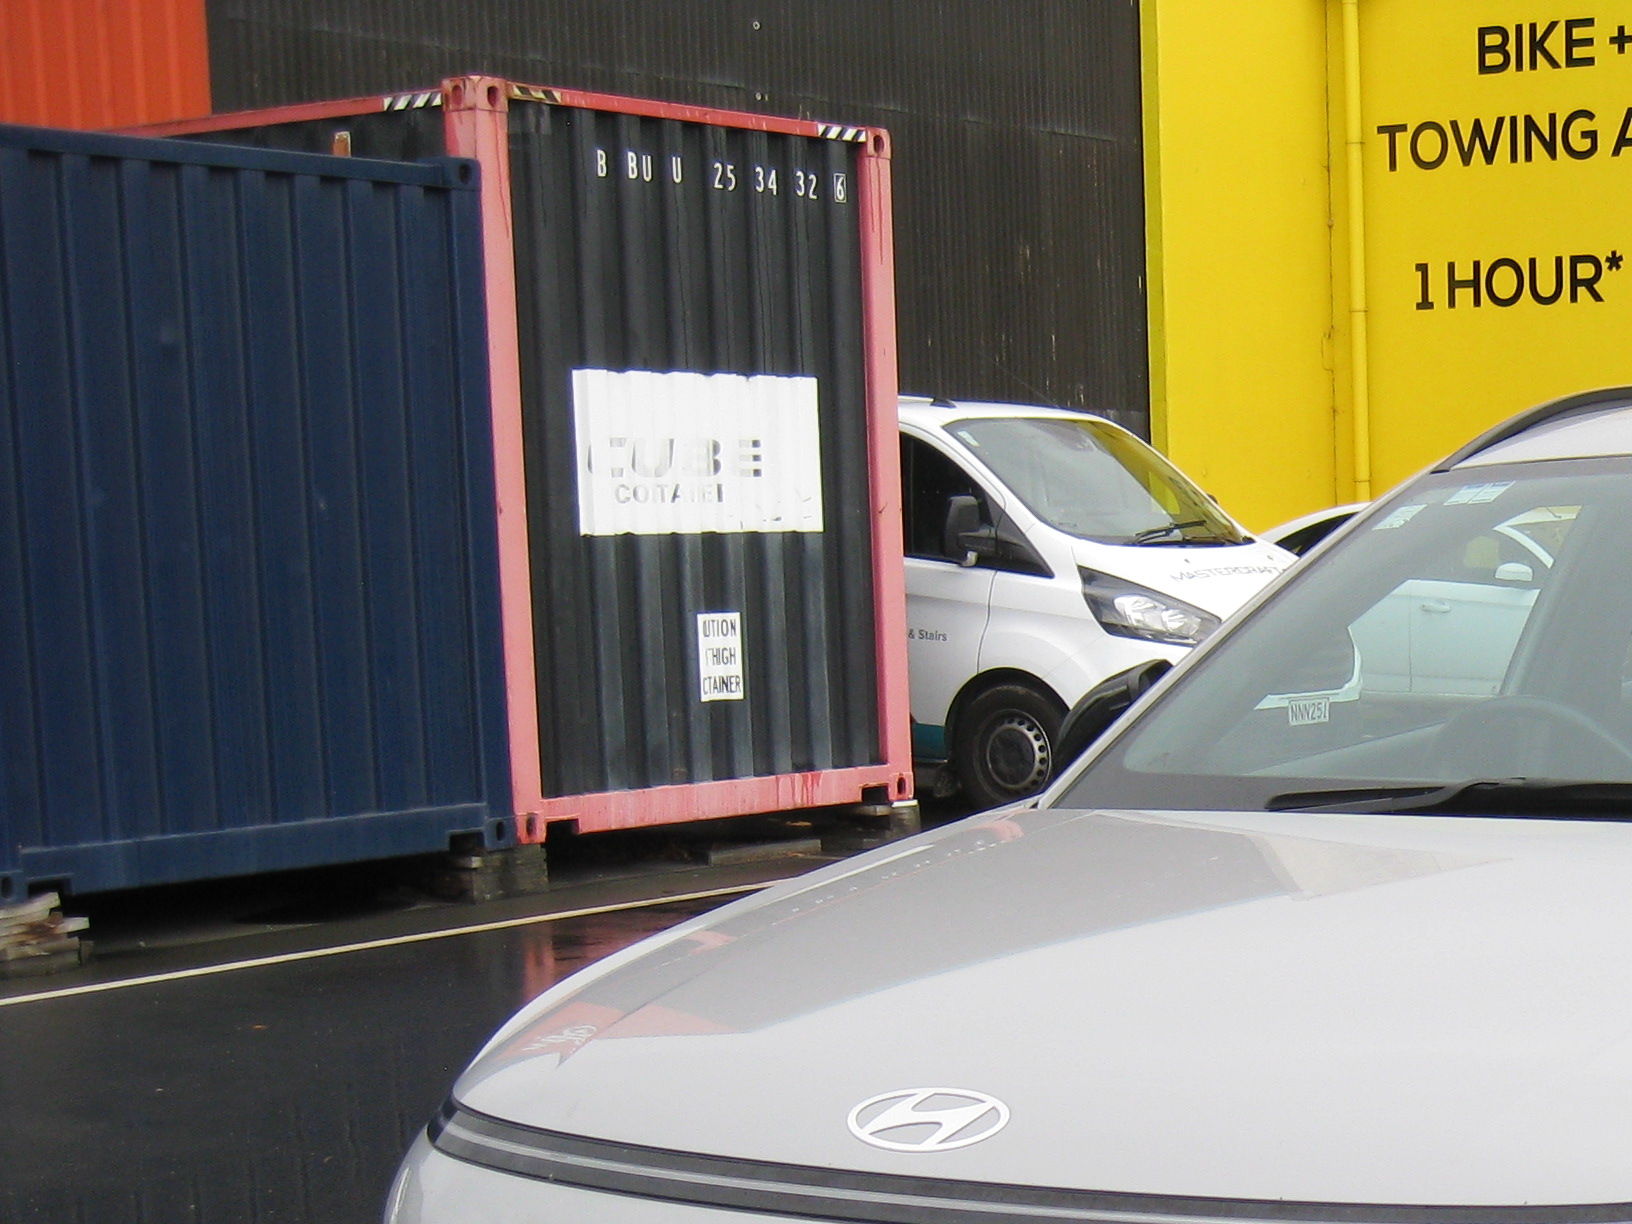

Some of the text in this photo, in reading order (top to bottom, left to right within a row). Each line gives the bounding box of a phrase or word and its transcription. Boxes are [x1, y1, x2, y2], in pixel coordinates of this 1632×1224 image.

[1477, 17, 1596, 75] BIKE
[1377, 108, 1599, 172] TOWING
[1415, 263, 1434, 311] 1
[908, 628, 948, 642] & Stairs
